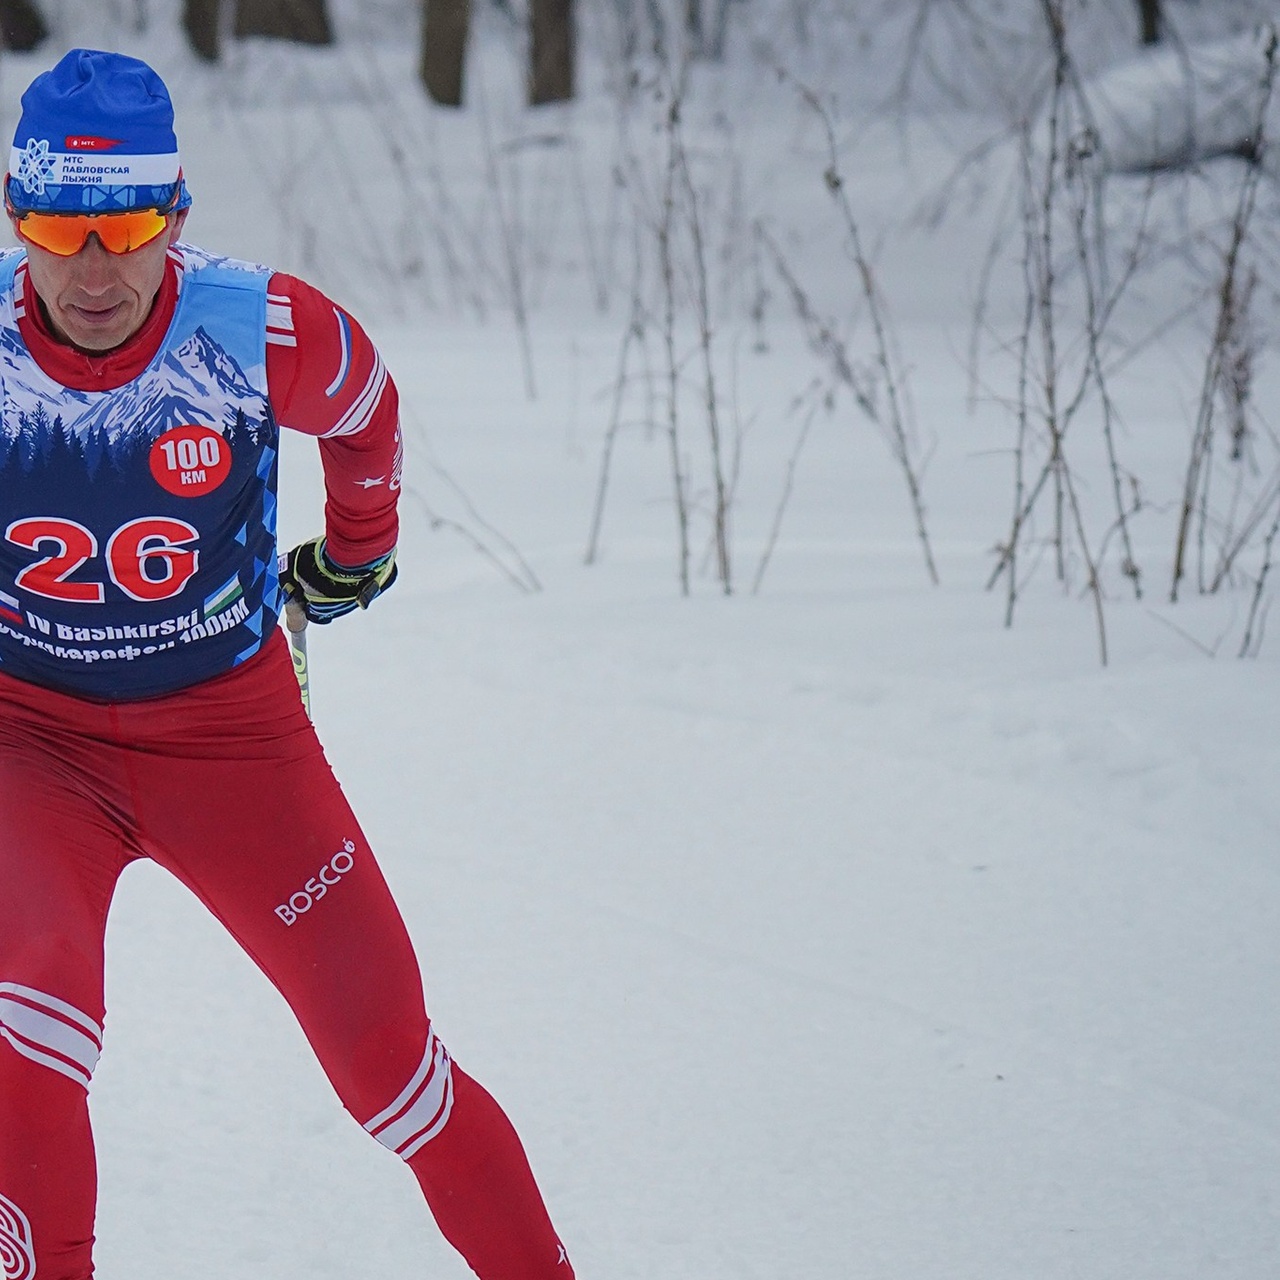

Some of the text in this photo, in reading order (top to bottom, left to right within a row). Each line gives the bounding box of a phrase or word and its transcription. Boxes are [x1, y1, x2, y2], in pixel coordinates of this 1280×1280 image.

[62, 165, 130, 174] ПАВЛОВСКАЯ
[64, 156, 84, 164] МТС
[61, 175, 103, 183] ЛЫЖНЯ
[160, 436, 220, 470] 100
[5, 516, 200, 603] 26
[26, 610, 51, 635] IV
[274, 851, 354, 927] BOSCO
